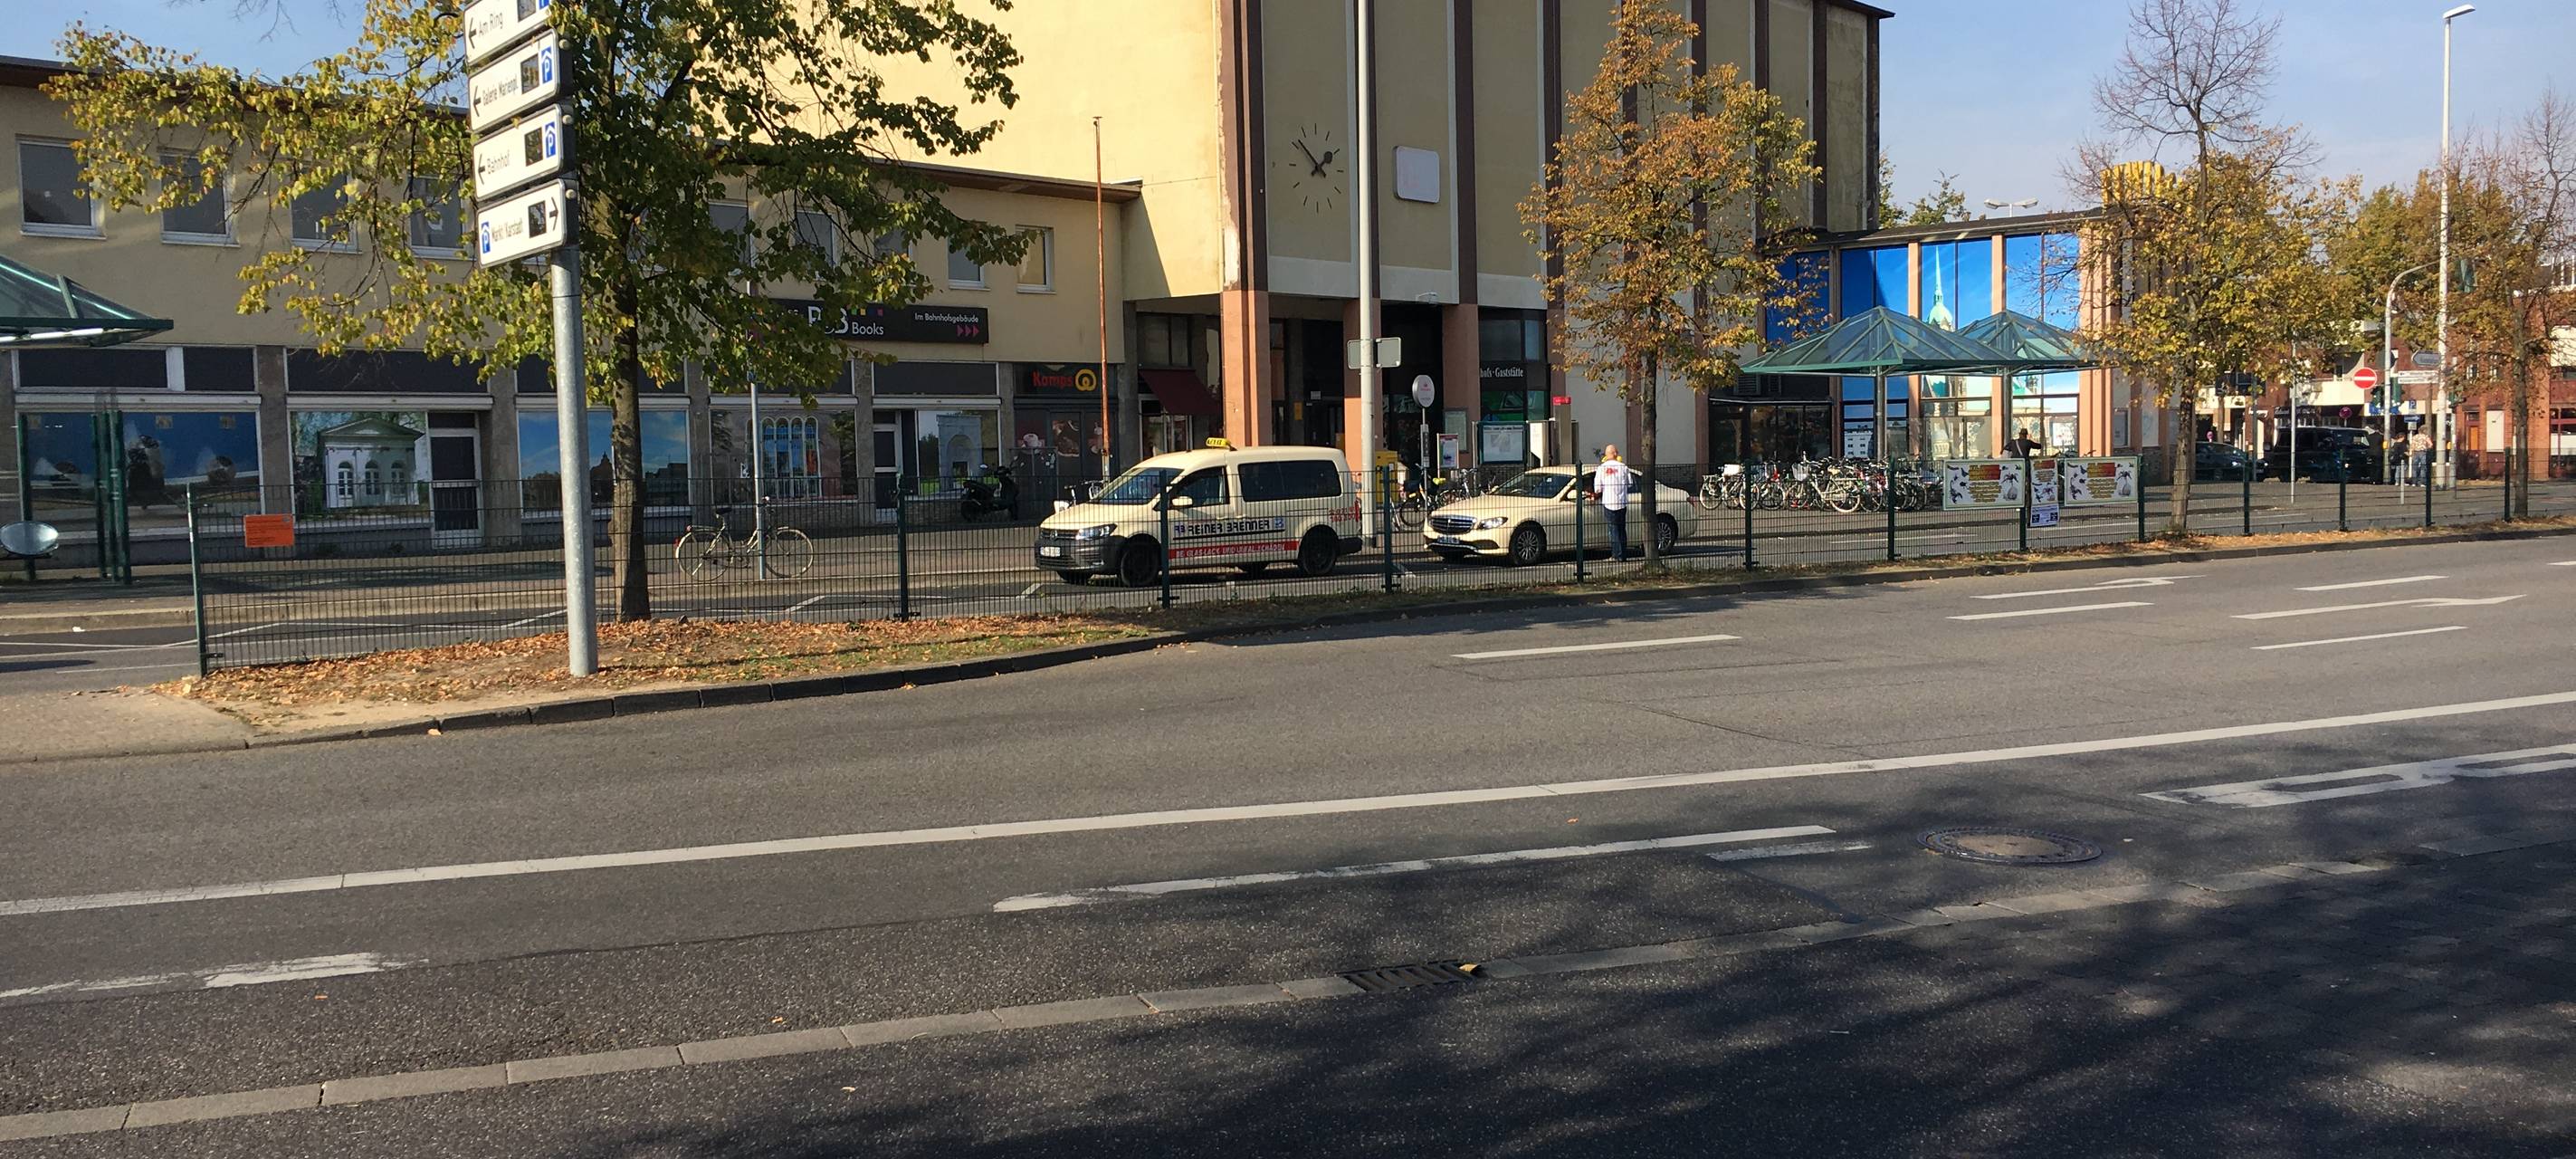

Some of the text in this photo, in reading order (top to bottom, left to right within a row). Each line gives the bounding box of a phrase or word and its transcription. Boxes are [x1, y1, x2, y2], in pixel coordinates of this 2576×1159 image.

[479, 12, 503, 37] Am Ring
[487, 149, 510, 175] Bahnhof
[852, 321, 884, 335] Books
[924, 313, 978, 324] Bahnhofsgebäude
[1032, 369, 1073, 389] Kamps
